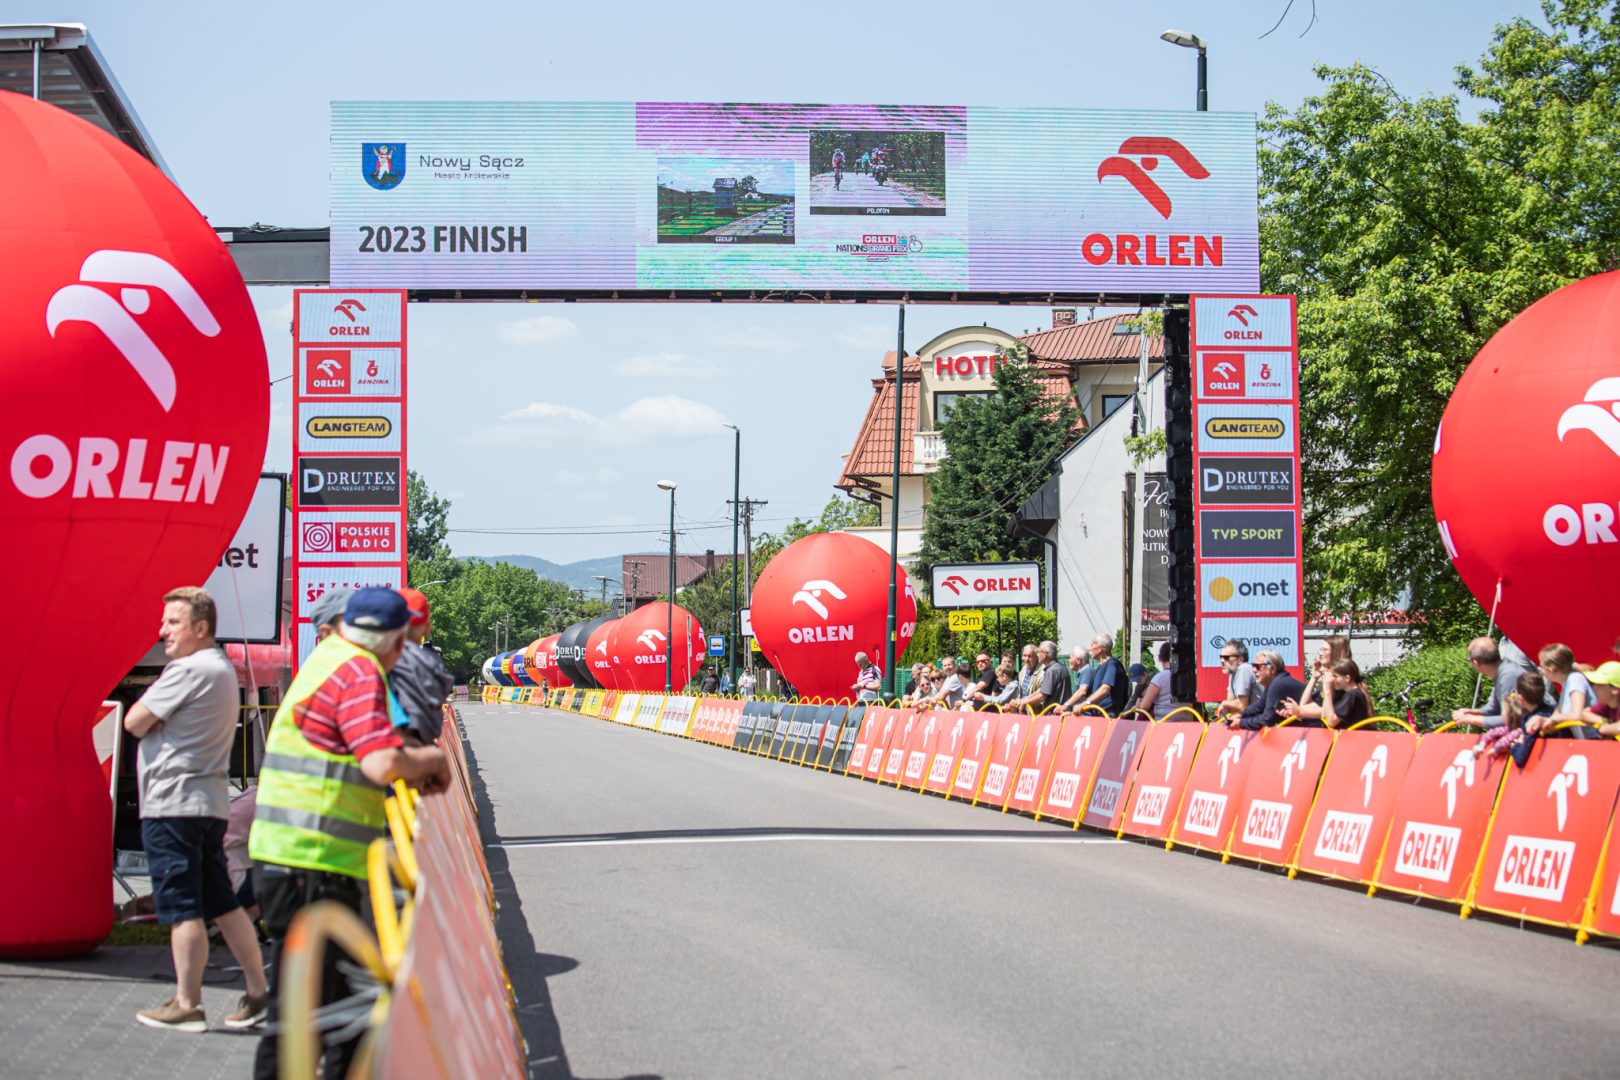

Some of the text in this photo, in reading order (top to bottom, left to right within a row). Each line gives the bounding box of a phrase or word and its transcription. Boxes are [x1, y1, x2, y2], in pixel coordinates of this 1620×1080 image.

[420, 154, 524, 170] Nowy Sącz
[358, 226, 527, 252] 2023 FINISH
[1082, 233, 1222, 266] ORLEN
[329, 326, 370, 336] ORLEN
[1224, 331, 1262, 340] ORLEN
[313, 379, 344, 387] ORLEN
[314, 423, 385, 432] LANGTEAM
[1212, 424, 1279, 432] LANGTEAM
[10, 434, 230, 504] ORLEN
[327, 472, 395, 485] DRUTEX
[1226, 472, 1290, 484] DRUTEX
[341, 526, 390, 536] POLSKIE
[1543, 503, 1620, 546] OR
[1212, 528, 1283, 540] TVP SPORT
[341, 538, 390, 548] RADIO
[974, 577, 1031, 592] ORLEN
[1239, 579, 1289, 596] onet
[952, 615, 980, 626] 25m
[1140, 623, 1165, 631] ashion
[788, 625, 854, 644] ORLEN
[1052, 778, 1075, 801] ORLEN
[1092, 784, 1120, 811] ORLEN
[1137, 792, 1166, 818] ORLEN
[1185, 794, 1223, 830] ORLEN
[1245, 807, 1286, 841] ORLEN
[1322, 818, 1363, 857] ORLEN
[1403, 831, 1454, 872] ORLEN
[1504, 846, 1567, 890] ORLEN
